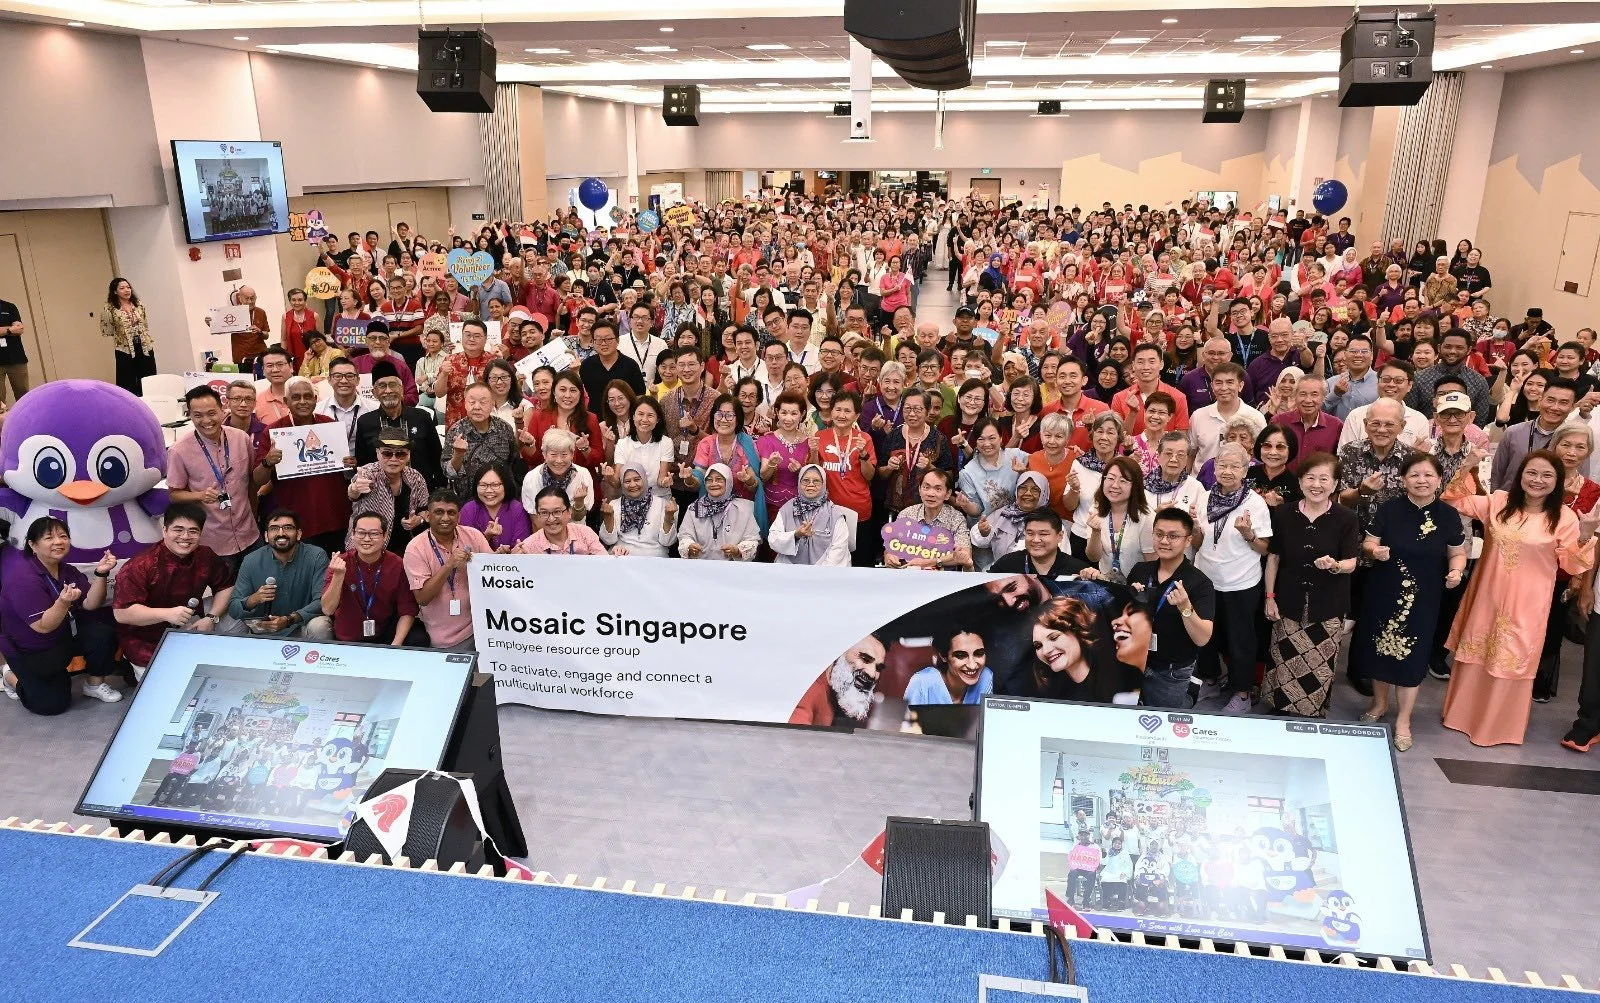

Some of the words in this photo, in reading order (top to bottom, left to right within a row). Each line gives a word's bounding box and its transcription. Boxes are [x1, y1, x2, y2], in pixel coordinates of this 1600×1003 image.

[451, 263, 491, 275] Volunteer
[319, 281, 340, 294] Day
[336, 335, 368, 345] COHES
[906, 529, 912, 538] I
[912, 532, 927, 541] am
[481, 563, 520, 573] micron
[481, 575, 535, 589] Mosaic
[485, 608, 586, 636] Mosaic
[596, 612, 747, 645] Singapore
[487, 637, 543, 654] Employee
[546, 644, 600, 655] resource
[603, 646, 641, 658] group
[306, 653, 318, 661] SG
[319, 654, 340, 663] Cares
[490, 661, 508, 672] To
[510, 663, 561, 679] activate,
[564, 670, 613, 684] engage
[616, 670, 642, 682] and
[645, 672, 701, 684] connect
[704, 675, 713, 684] a
[494, 677, 567, 694] multicultural
[570, 686, 634, 700] workforce
[1174, 725, 1188, 734] SG
[1191, 727, 1218, 736] Cares
[1136, 919, 1146, 928] To
[1148, 921, 1167, 930] Serve
[1168, 923, 1183, 932] with
[1185, 924, 1202, 934] Love
[1202, 928, 1216, 936] and
[1217, 927, 1234, 938] Care
